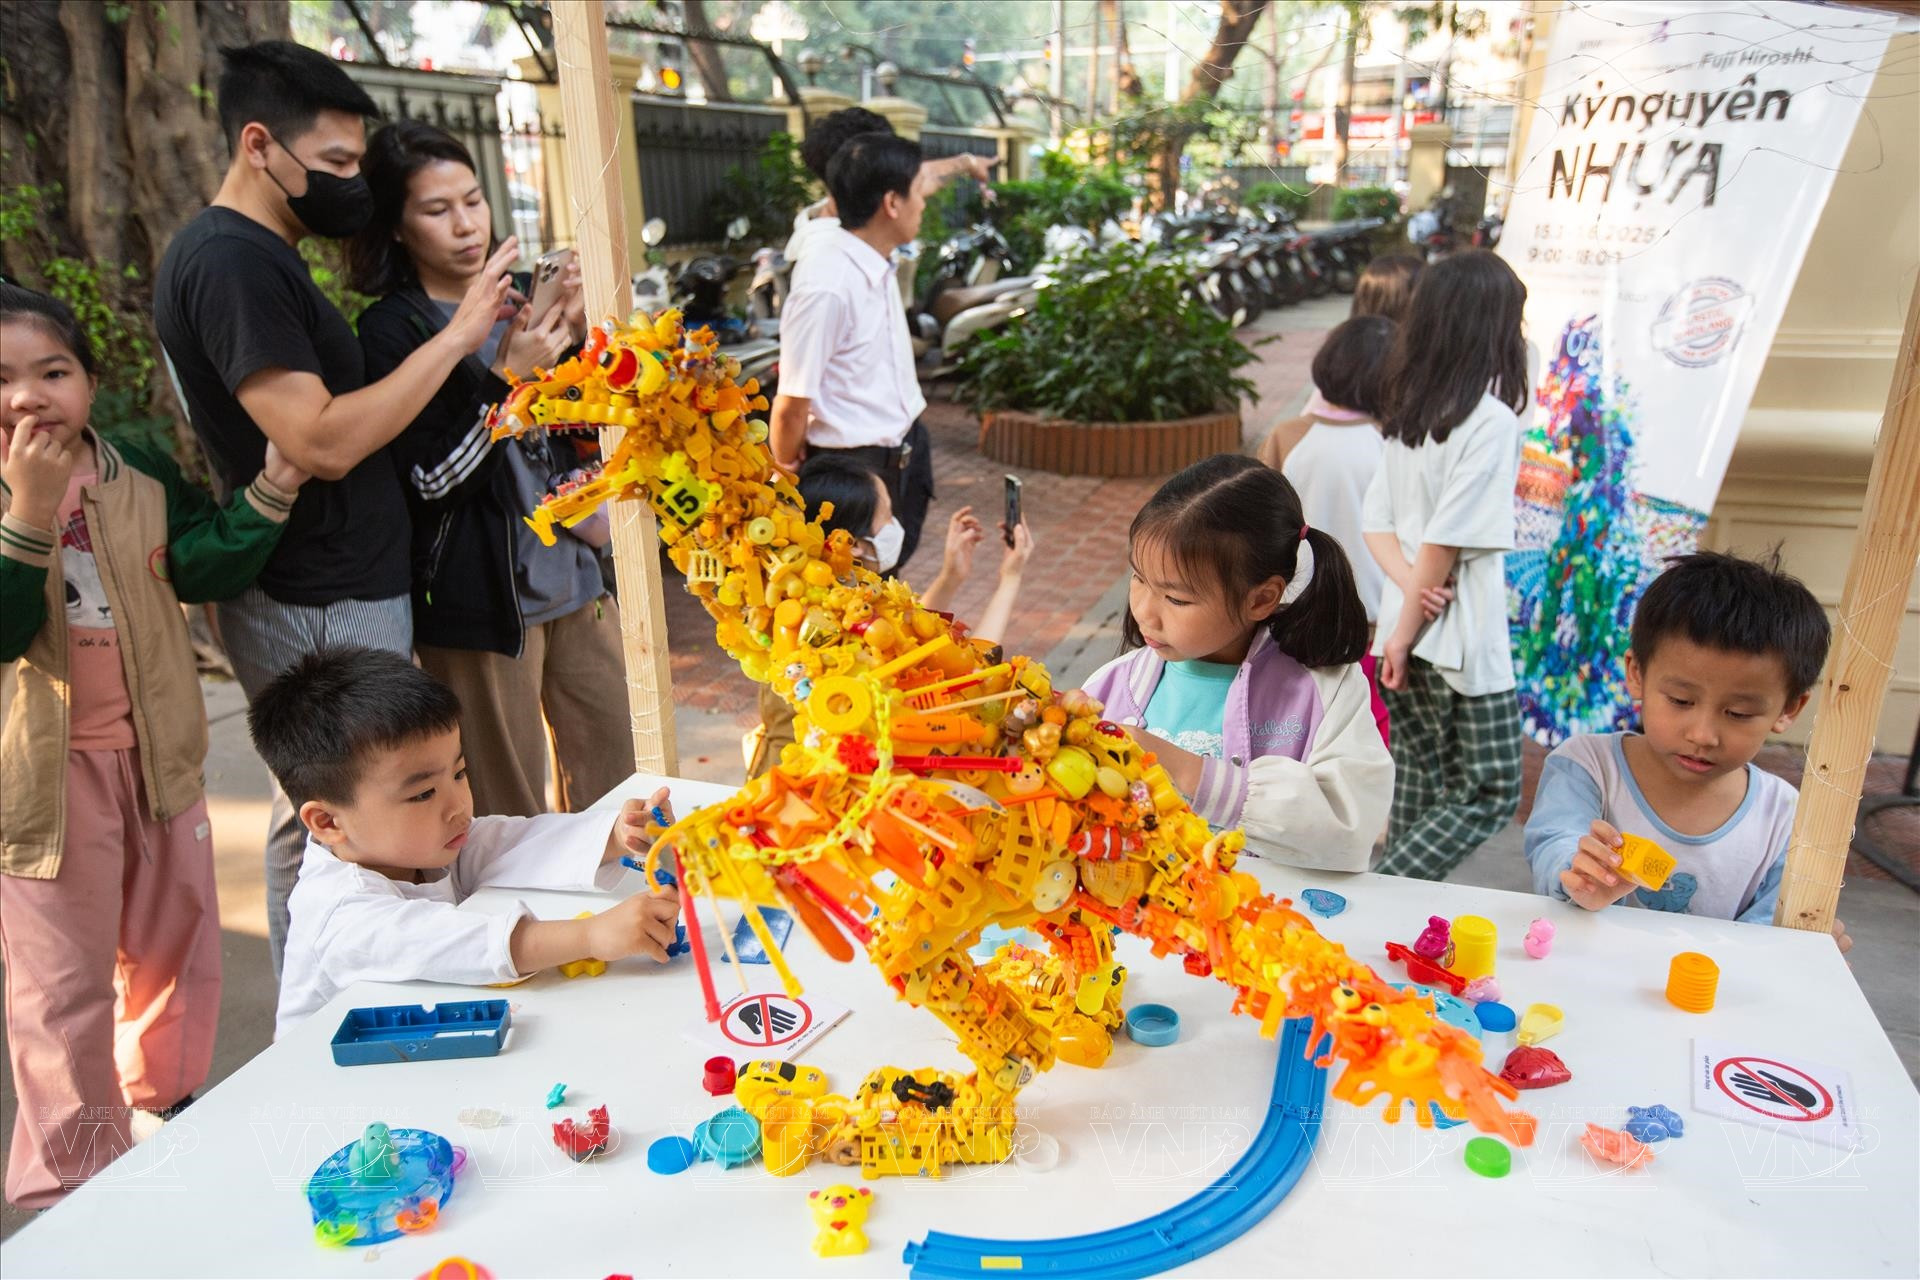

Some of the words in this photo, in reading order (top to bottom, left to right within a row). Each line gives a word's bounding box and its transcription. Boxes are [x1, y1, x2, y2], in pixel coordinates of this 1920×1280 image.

[1700, 52, 1736, 72] Fuji
[1739, 46, 1815, 67] Hiroshi
[673, 488, 699, 514] 5
